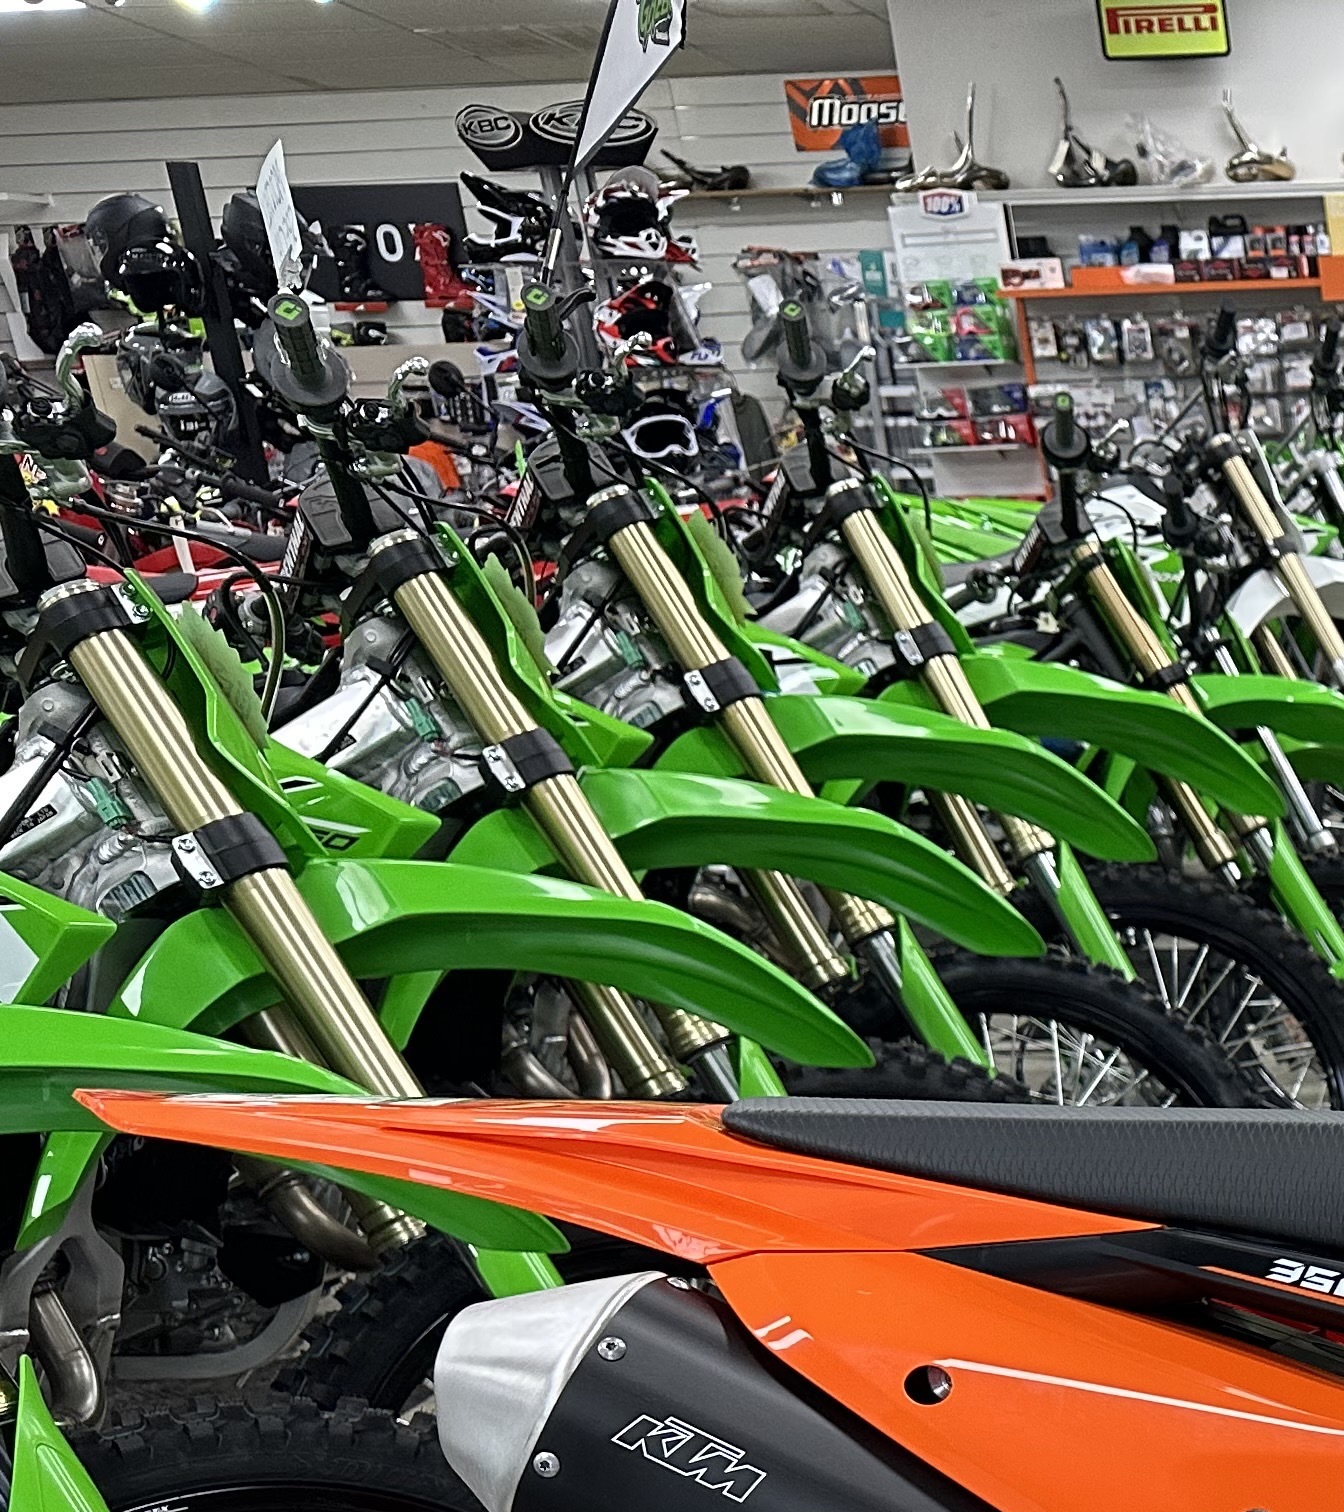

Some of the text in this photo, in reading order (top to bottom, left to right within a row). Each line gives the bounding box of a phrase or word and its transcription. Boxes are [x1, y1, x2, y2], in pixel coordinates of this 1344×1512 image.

[1106, 4, 1218, 34] PIRELLI
[463, 116, 512, 136] KBC
[541, 112, 644, 130] KC
[611, 1414, 767, 1503] KTM
